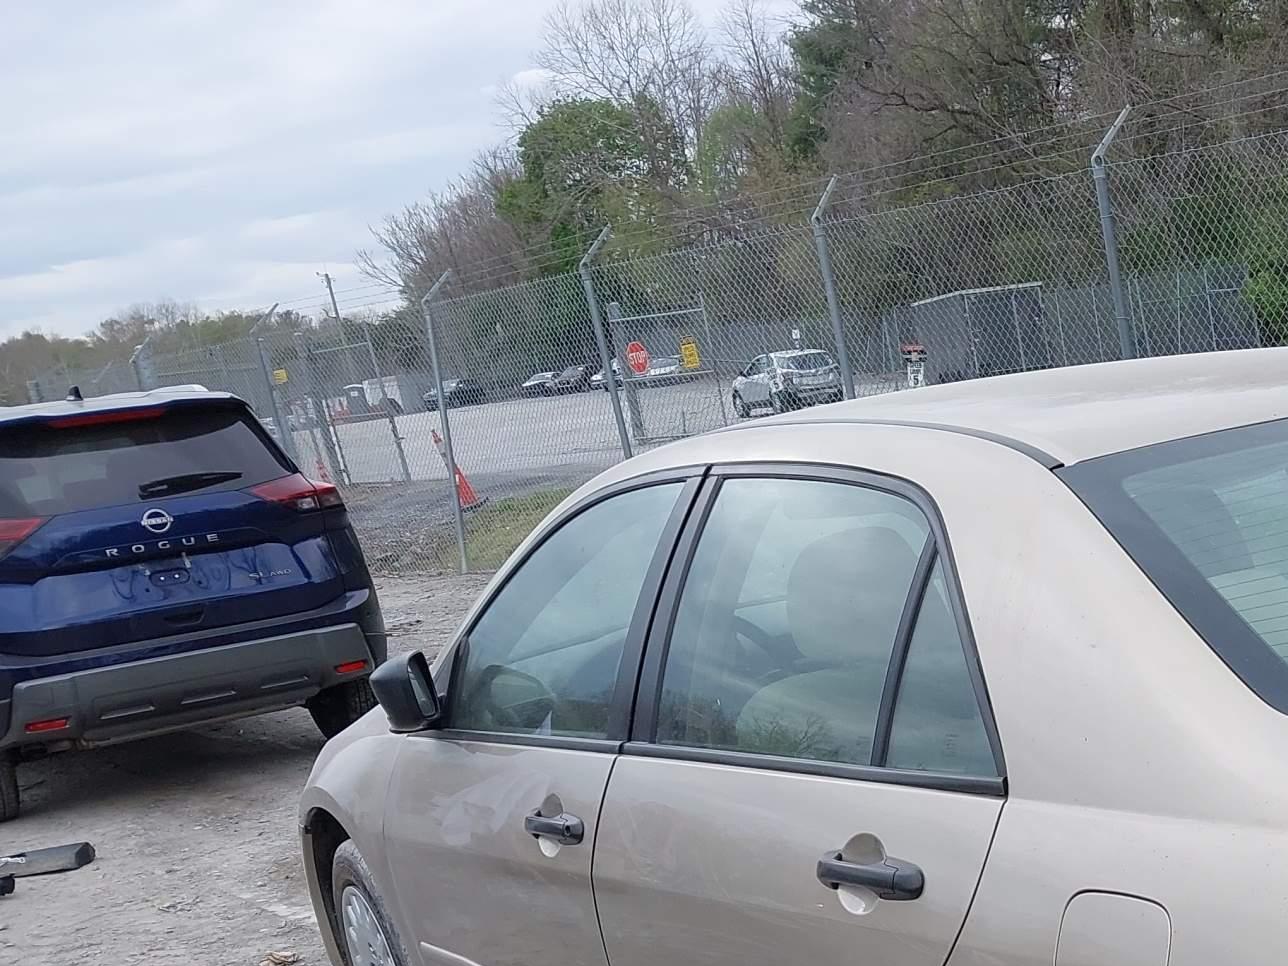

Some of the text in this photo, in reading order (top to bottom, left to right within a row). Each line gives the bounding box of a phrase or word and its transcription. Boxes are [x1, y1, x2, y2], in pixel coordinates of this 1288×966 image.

[628, 351, 646, 365] STOP
[105, 533, 219, 557] ROGUE
[270, 568, 292, 577] AWD
